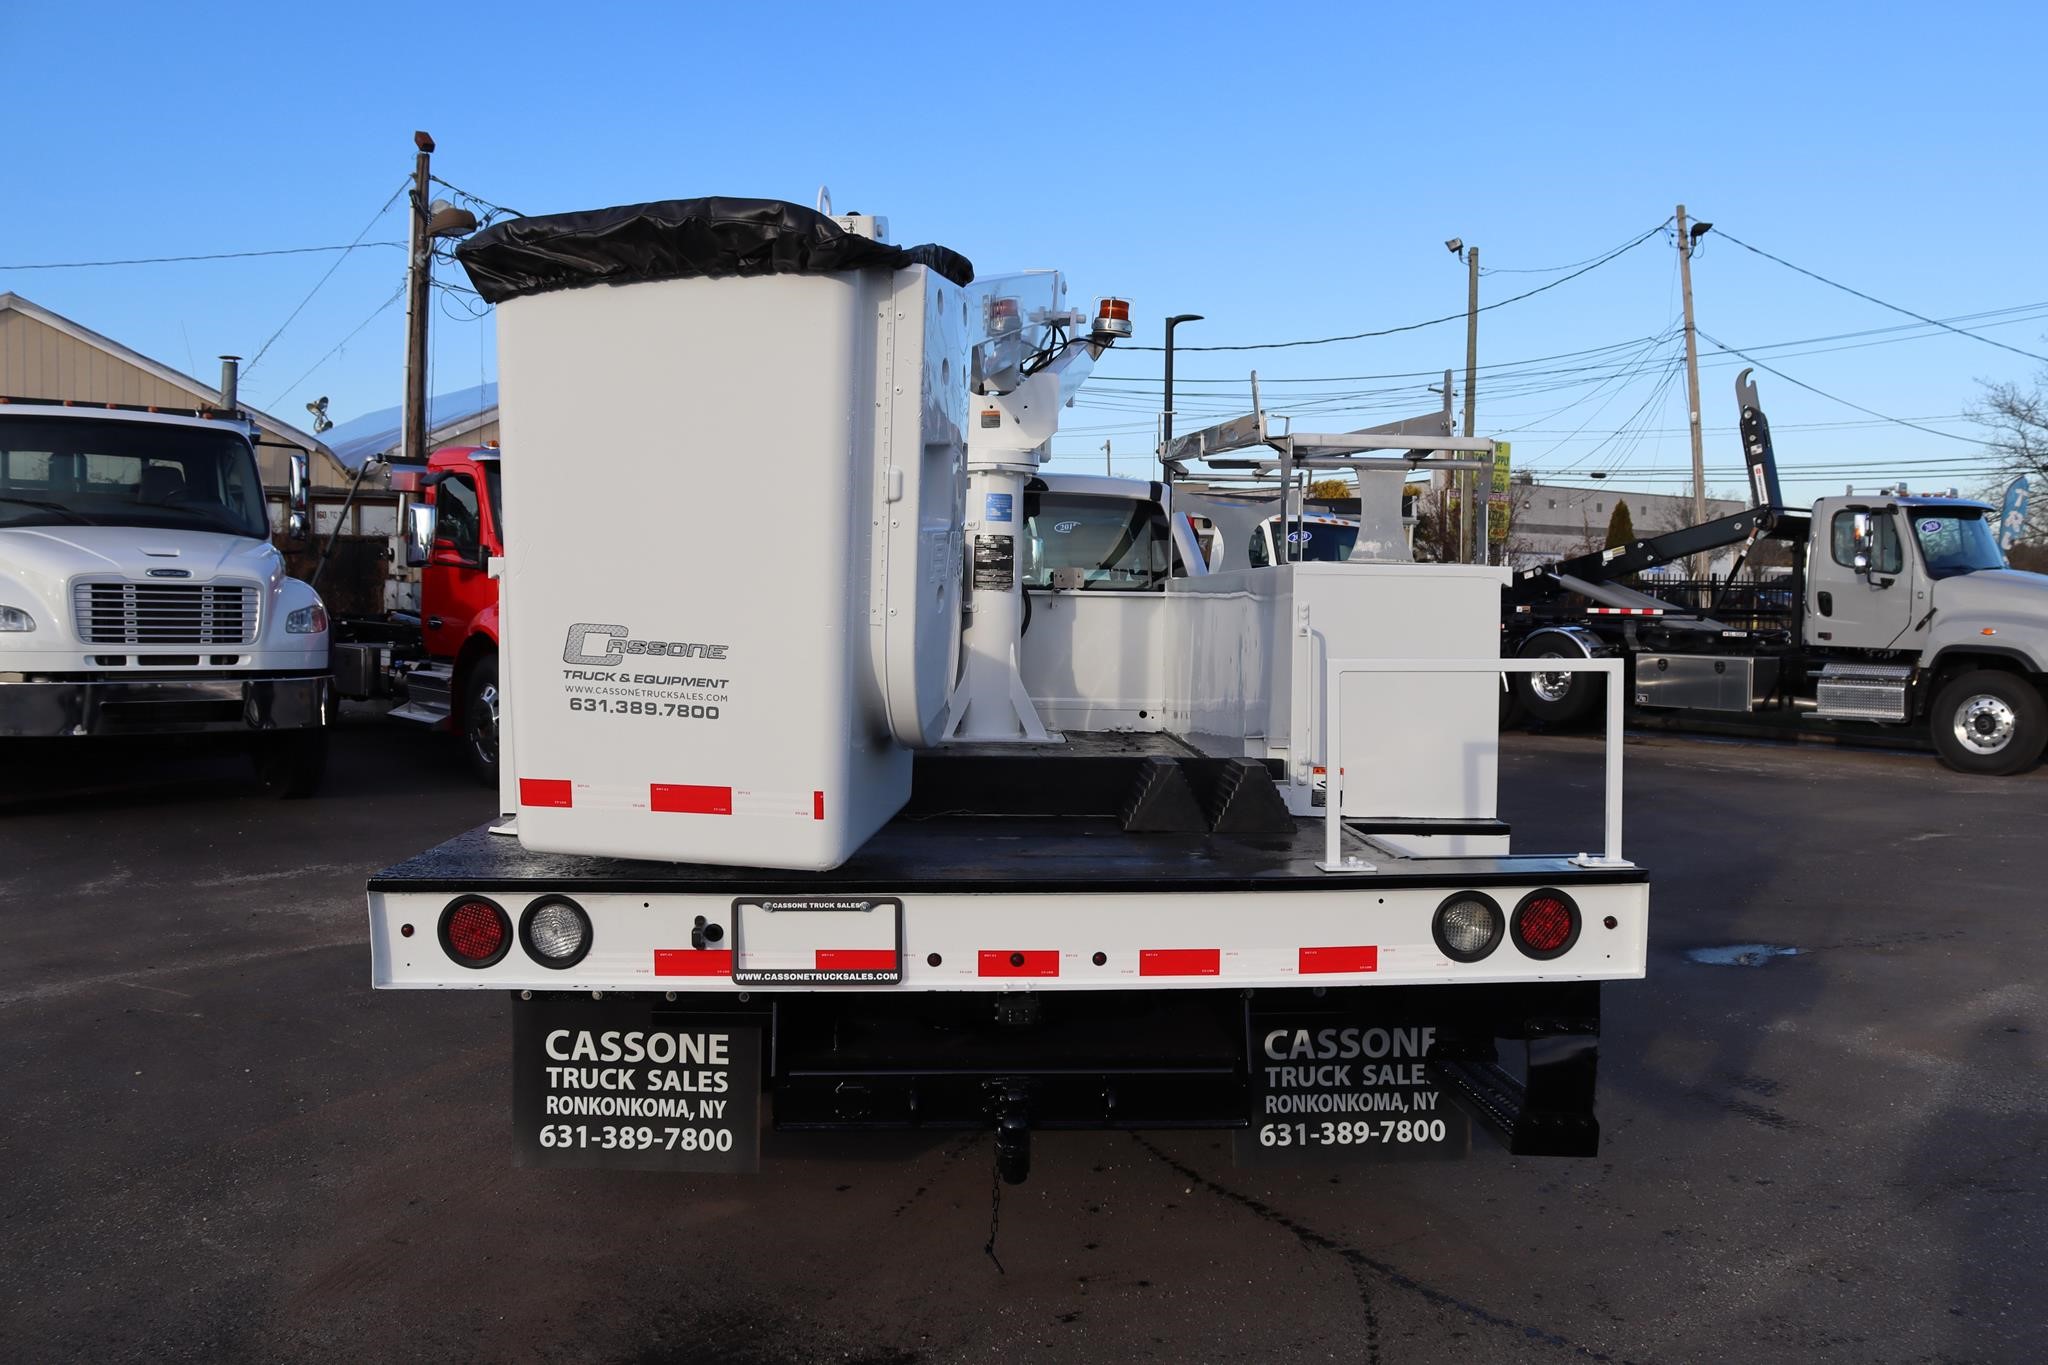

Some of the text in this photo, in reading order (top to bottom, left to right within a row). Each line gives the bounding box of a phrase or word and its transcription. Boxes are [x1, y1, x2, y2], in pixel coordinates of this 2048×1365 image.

[562, 622, 729, 667] CASSONE
[562, 669, 730, 690] TRUCK & EQUIPMENT
[565, 685, 728, 703] WWW.CASSONETRUCKSALES.COM
[569, 697, 720, 720] 631.389.7800
[772, 901, 808, 909] CASSONE
[735, 972, 898, 981] WWW.CASSONETRUCKSALES.COM
[545, 1029, 730, 1065] CASSONE
[545, 1066, 729, 1093] TRUCK SALES
[1264, 1063, 1433, 1088] TRUCK SALE
[546, 1095, 727, 1122] RONKONKOMA, NY
[1265, 1091, 1440, 1114] RONKONKOMA, NY
[539, 1124, 733, 1152] 631-389-7800
[1259, 1119, 1446, 1147] 631-389-7800
